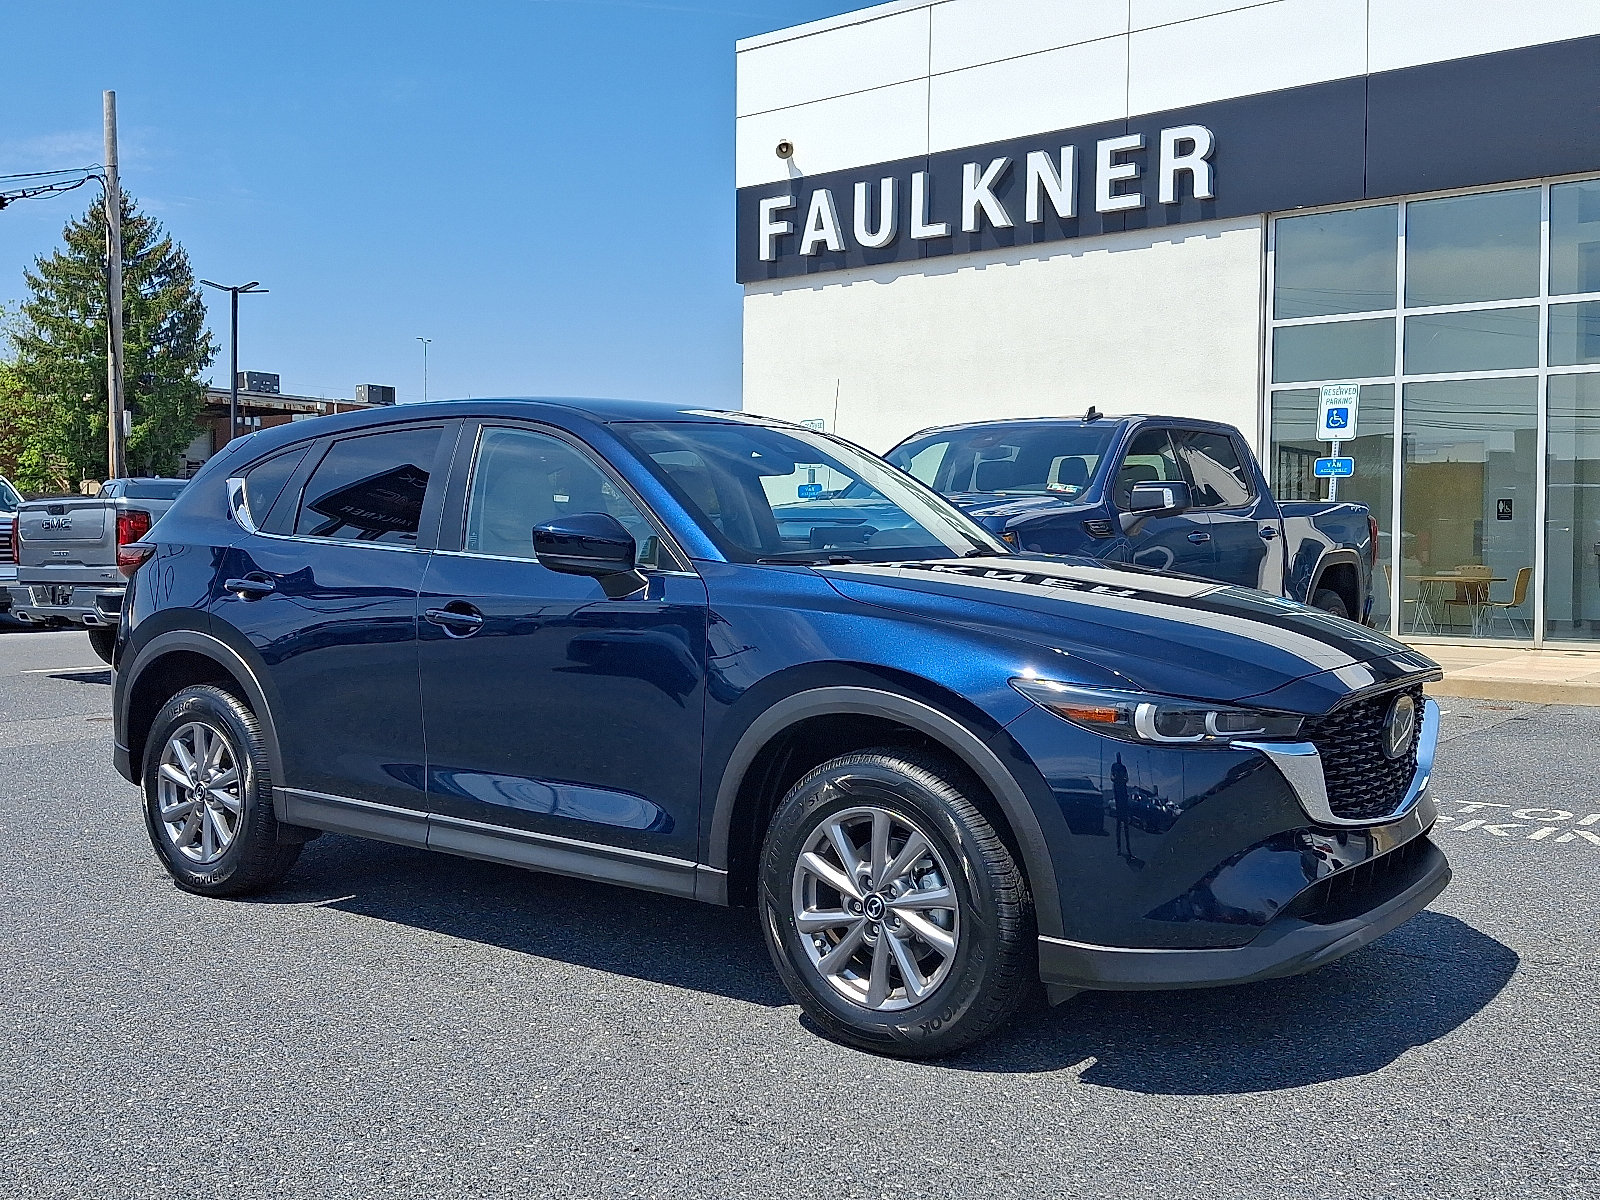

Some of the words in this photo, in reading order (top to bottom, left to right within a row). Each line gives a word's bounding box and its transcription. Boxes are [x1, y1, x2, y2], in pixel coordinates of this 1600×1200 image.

[758, 124, 1217, 262] FAULKNER
[1323, 387, 1357, 396] RESERVED
[1325, 397, 1353, 405] PARKING
[41, 517, 73, 530] GMC
